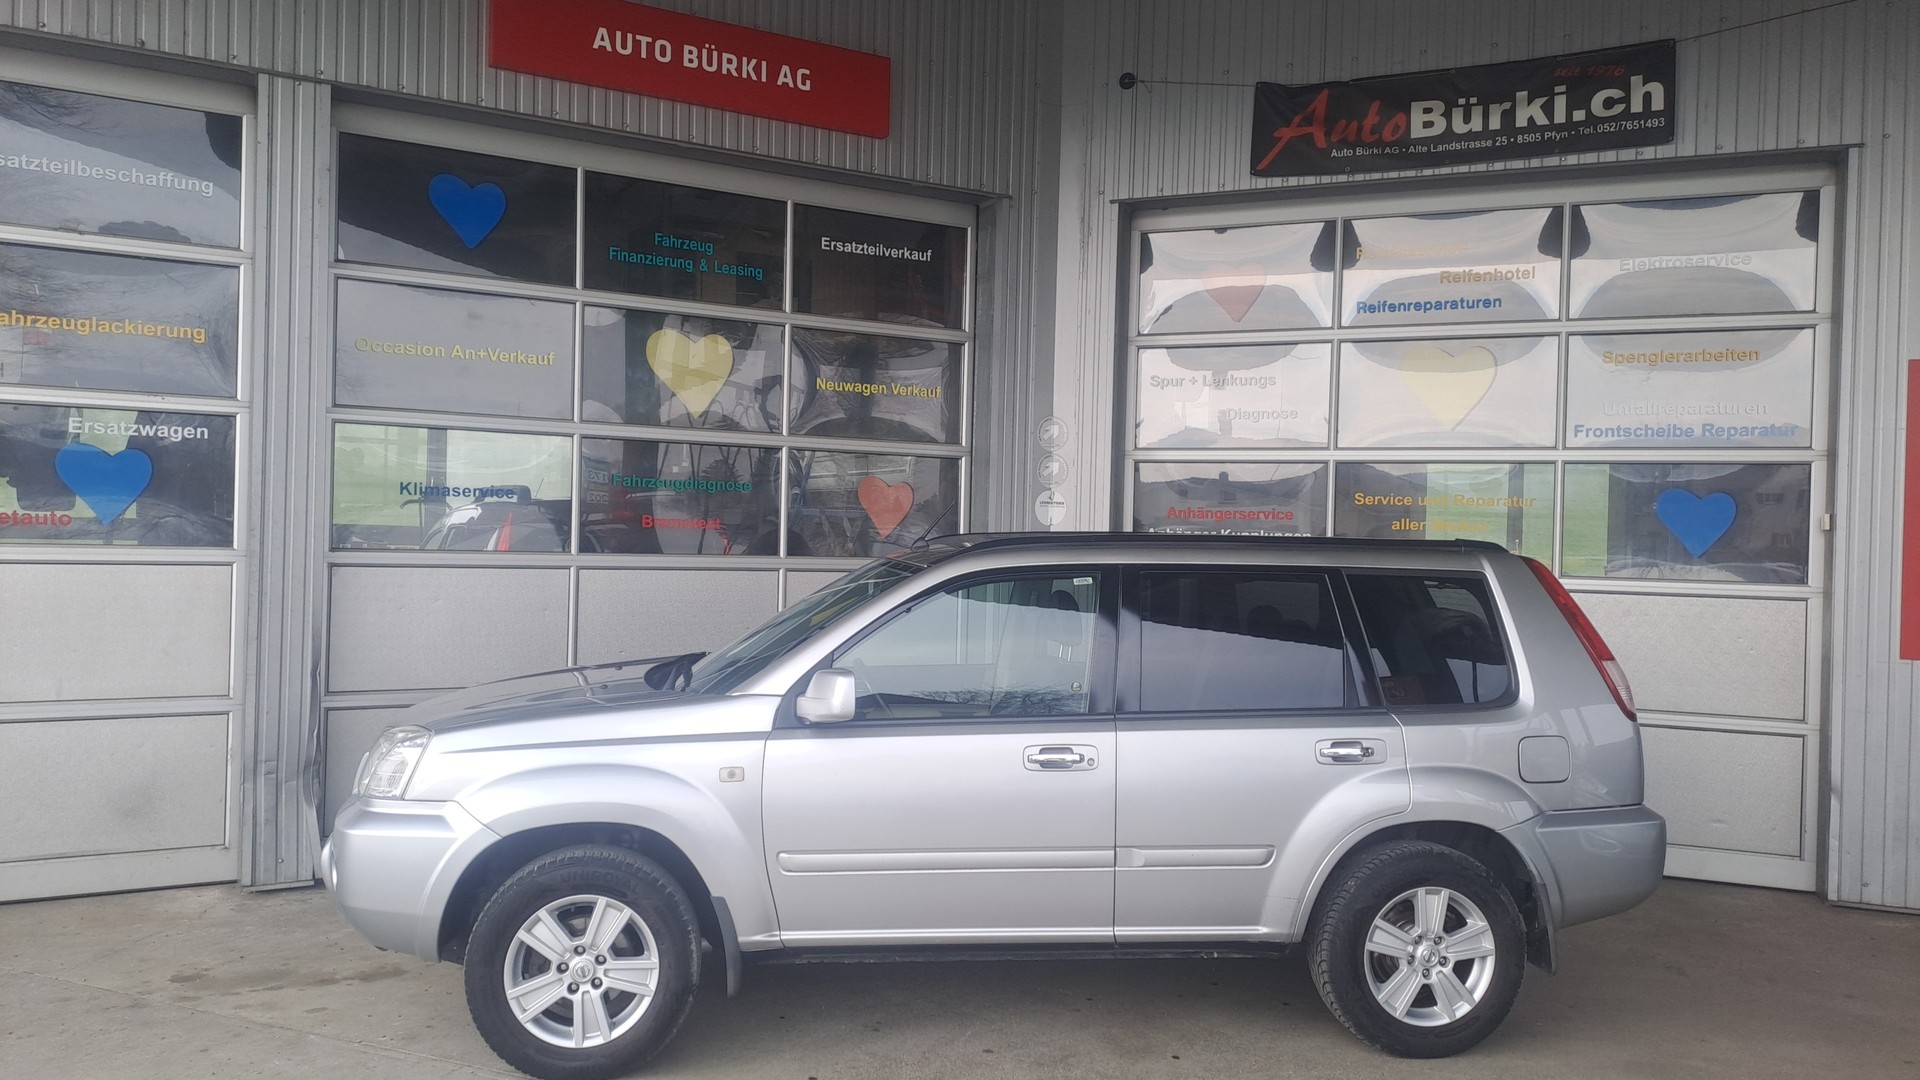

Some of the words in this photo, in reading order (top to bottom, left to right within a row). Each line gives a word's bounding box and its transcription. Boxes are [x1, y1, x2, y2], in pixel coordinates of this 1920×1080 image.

[592, 27, 672, 63] AUTO
[683, 43, 767, 82] BÜRKI
[776, 65, 811, 91] AG
[1331, 148, 1353, 158] Auto
[1356, 146, 1382, 156] Bürki
[1408, 145, 1428, 154] Alte
[1431, 138, 1492, 152] Landstrasse
[1495, 136, 1508, 146] 25
[1517, 132, 1542, 144] 8505
[1545, 130, 1568, 143] Pfyn
[654, 232, 714, 256] Fahrzeug
[821, 237, 932, 262] Ersatzteilverkauf
[609, 247, 693, 272] Finanzierung
[700, 258, 709, 271] &
[714, 260, 764, 281] Leasing
[1619, 253, 1753, 273] Elektroservice
[1440, 266, 1536, 284] Reifenhotel
[1356, 296, 1502, 315] Reifenreparaturen
[355, 337, 445, 357] Occasion
[450, 344, 556, 366] An+Verkauf
[1602, 348, 1760, 367] Spenglerarbeiten
[816, 377, 887, 398] Neuwagen
[891, 382, 941, 399] Verkauf
[1150, 375, 1186, 390] Spur
[1202, 374, 1277, 389] Lenkungs
[1227, 408, 1298, 423] Diagnose
[68, 417, 209, 443] Ersatzwagen
[1573, 423, 1695, 439] Frontscheibe
[1701, 422, 1799, 440] Reparatur
[400, 482, 515, 499] Klimaservice
[612, 473, 752, 494] Fahrzeugdiagnose
[1354, 492, 1413, 506] Service
[1454, 493, 1537, 508] Reparatur
[0, 510, 73, 527] etauto
[641, 514, 721, 529] Bremstest
[1167, 506, 1294, 523] Anhängerservice
[1391, 518, 1427, 531] aller
